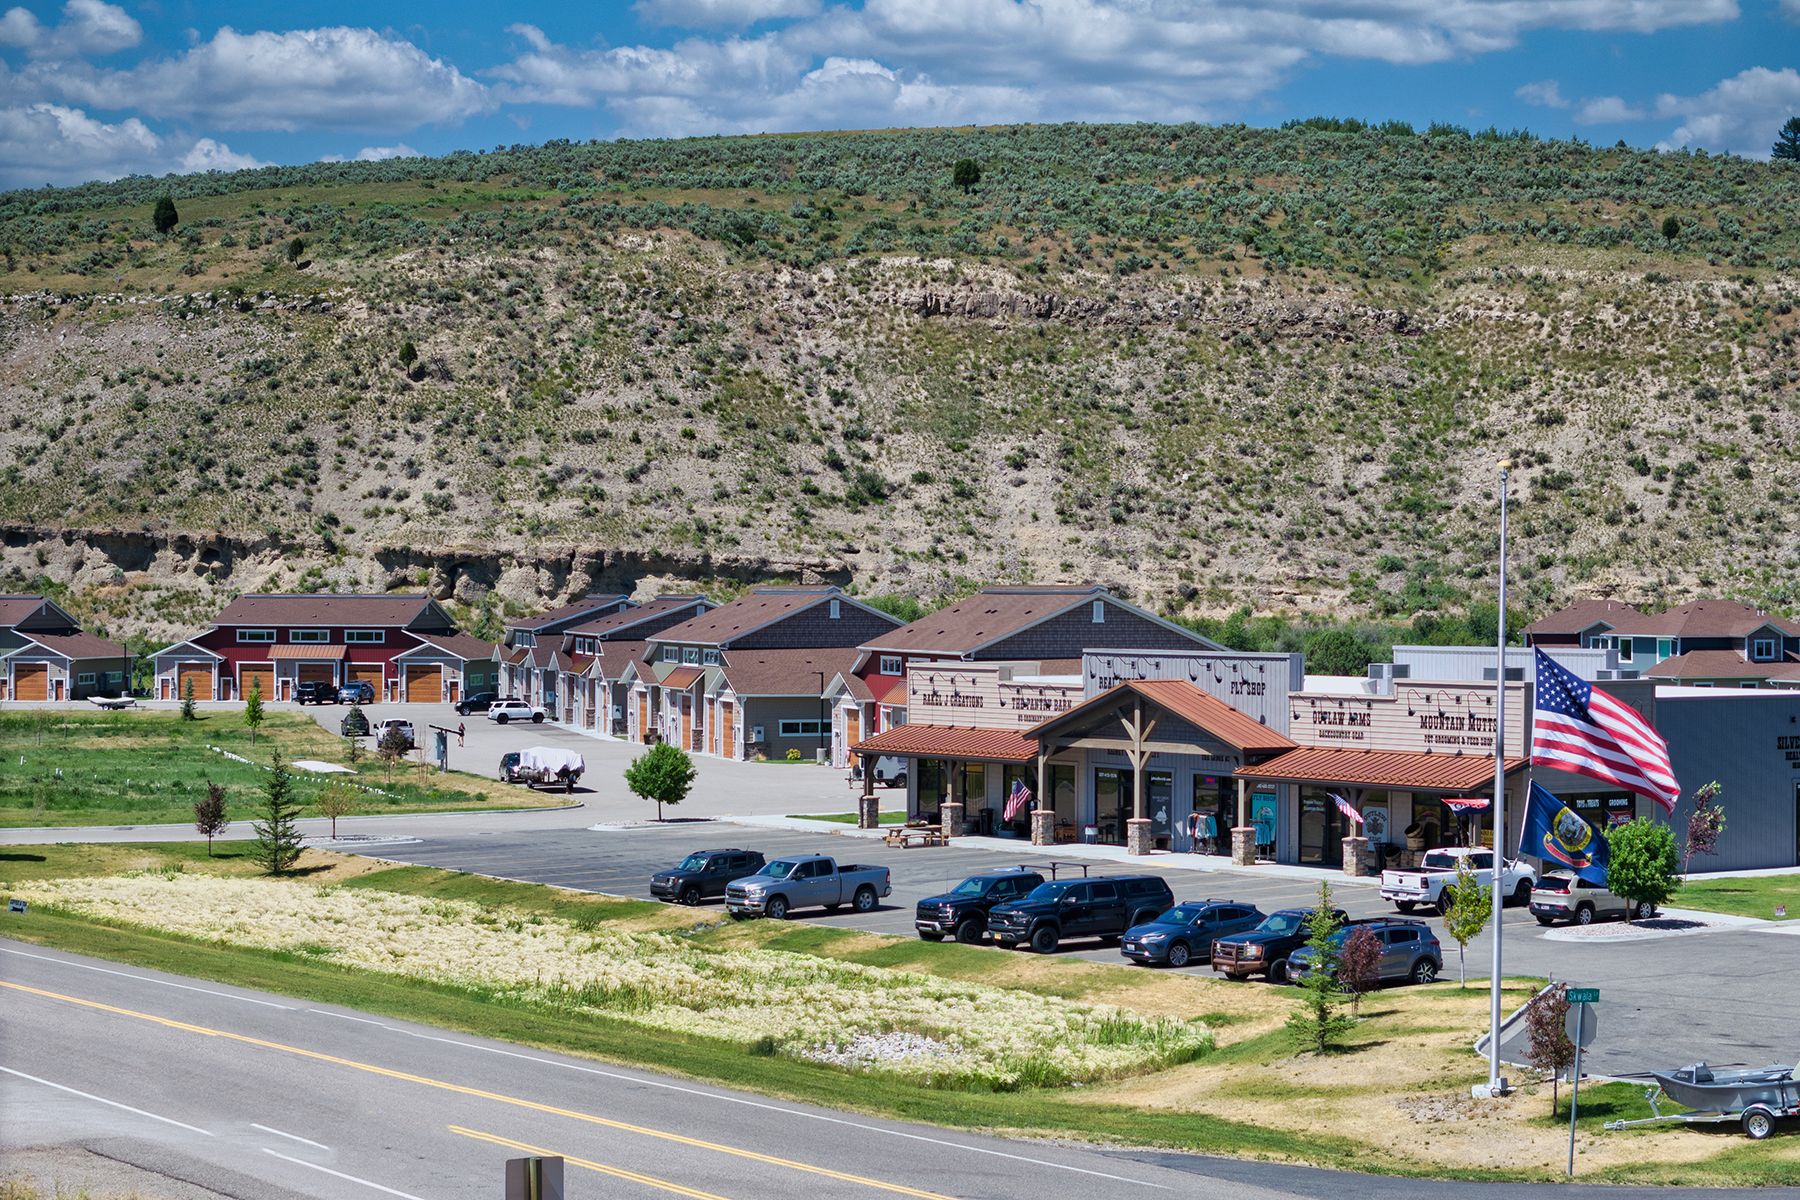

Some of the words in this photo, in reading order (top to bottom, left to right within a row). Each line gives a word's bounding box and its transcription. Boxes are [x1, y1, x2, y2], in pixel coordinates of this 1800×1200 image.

[1231, 681, 1245, 695] FLY
[1246, 682, 1266, 696] SHOP
[944, 694, 949, 706] J
[950, 694, 984, 708] CREATIONS
[1012, 697, 1025, 710] THE
[1026, 698, 1052, 711] PANTRY
[1054, 699, 1072, 711] BARN
[1312, 710, 1345, 725] OUTLAW
[1347, 712, 1371, 726] ARMS
[1420, 715, 1465, 731] MOUNTAIN
[1468, 717, 1497, 732] MUTTS
[1319, 729, 1351, 739] BACKCOUNTRY
[1352, 731, 1364, 740] GEAR
[1424, 734, 1434, 743] PET
[1435, 735, 1460, 745] GROOMING
[1467, 737, 1480, 746] FEED
[1480, 737, 1493, 746] SHOP
[1608, 798, 1628, 807] GROOMING
[1568, 991, 1592, 1001] Skwala
